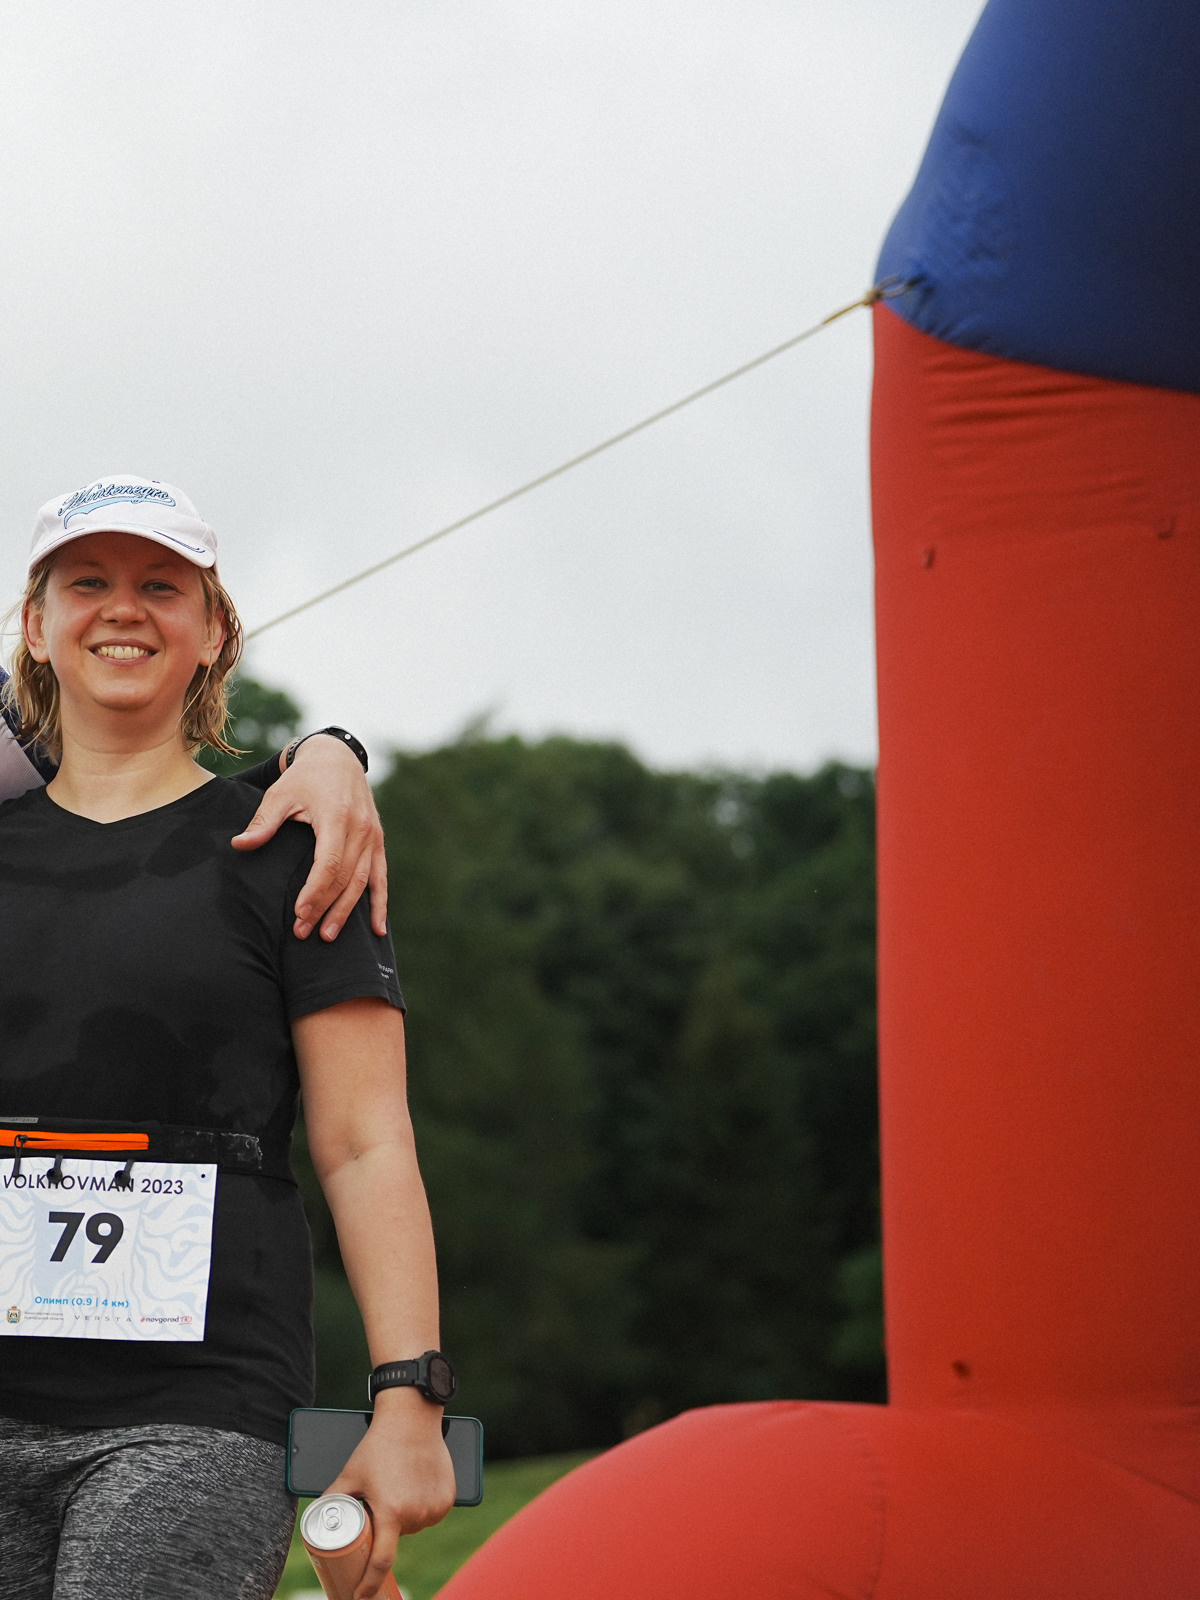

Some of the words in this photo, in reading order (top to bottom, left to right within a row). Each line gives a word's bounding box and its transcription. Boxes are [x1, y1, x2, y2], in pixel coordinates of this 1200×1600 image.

[140, 1177, 184, 1195] 2023
[48, 1211, 125, 1264] 79
[34, 1295, 69, 1305] Олимп
[71, 1297, 93, 1307] (0.9
[101, 1298, 109, 1307] 4
[111, 1299, 130, 1309] км)
[74, 1315, 132, 1323] VERSTA
